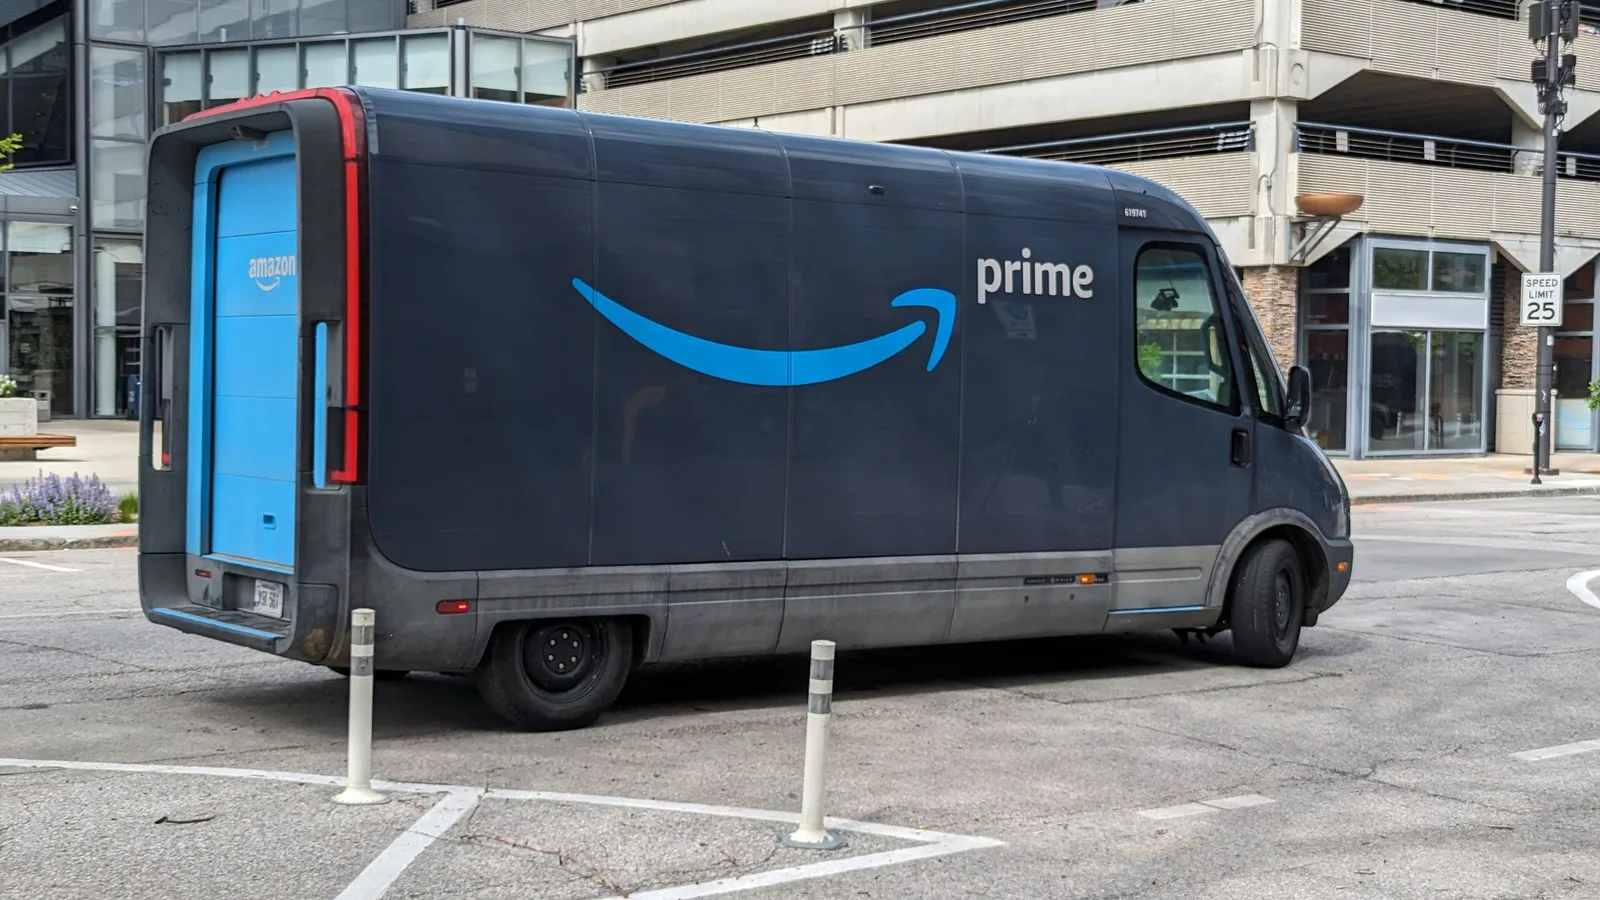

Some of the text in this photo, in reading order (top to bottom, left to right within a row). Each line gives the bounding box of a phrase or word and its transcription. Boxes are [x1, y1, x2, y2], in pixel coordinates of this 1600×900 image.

[249, 255, 296, 279] amazon
[977, 247, 1094, 304] prime
[1526, 279, 1559, 288] SPEED
[1528, 290, 1554, 299] LIMIT
[1527, 302, 1555, 320] 25
